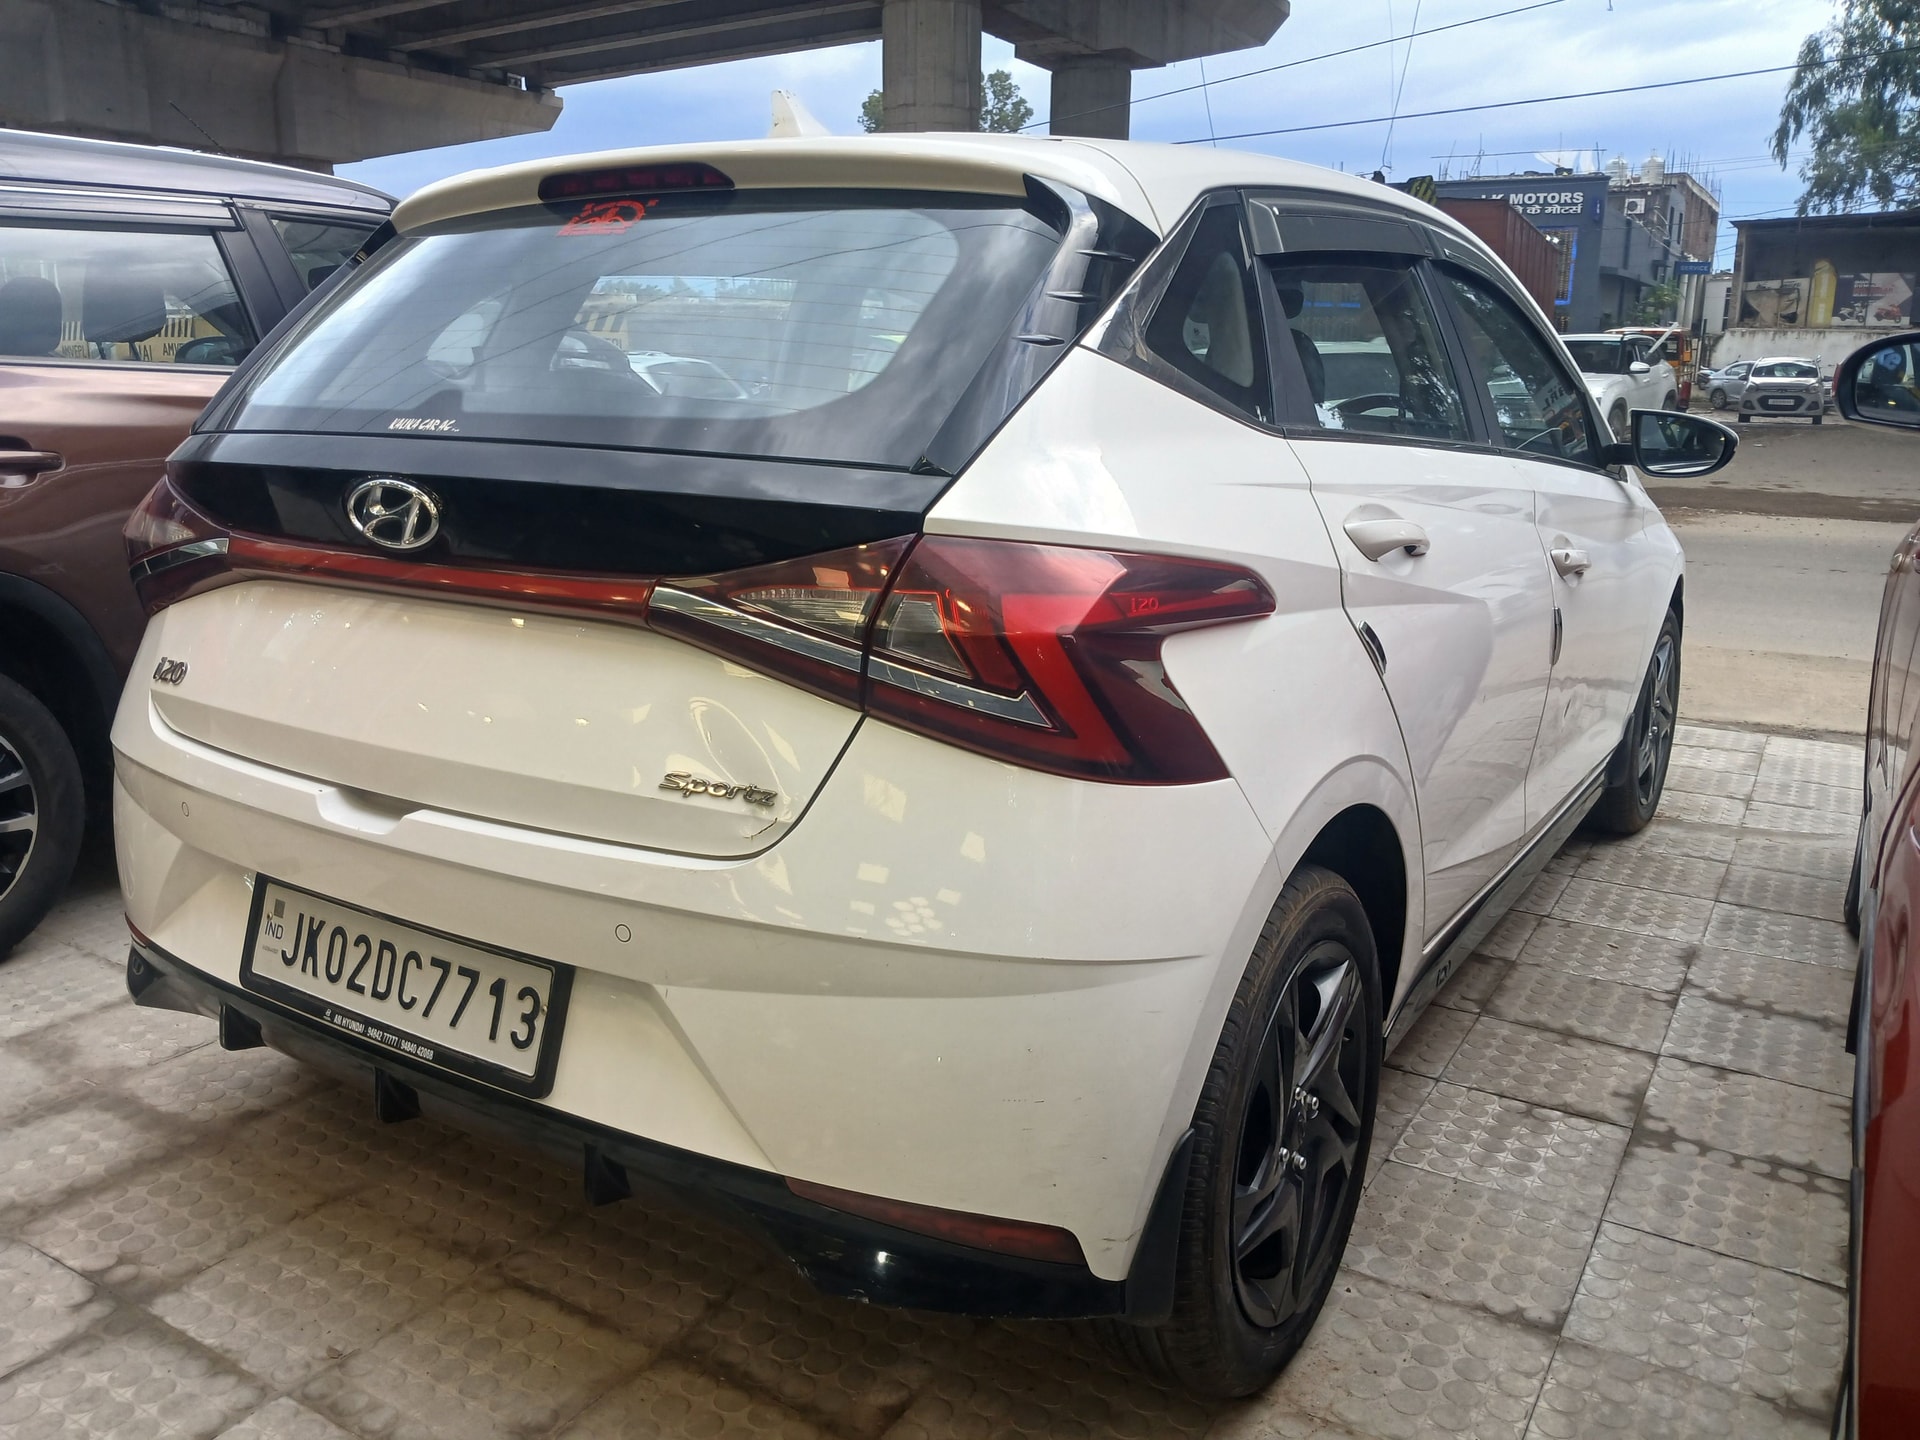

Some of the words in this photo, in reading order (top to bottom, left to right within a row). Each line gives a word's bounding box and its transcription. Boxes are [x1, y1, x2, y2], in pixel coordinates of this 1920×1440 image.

[1509, 192, 1584, 205] MOTORS
[1526, 204, 1542, 214] के
[1544, 204, 1583, 214] मोटर्स
[418, 418, 440, 432] CAR
[658, 770, 778, 806] Sportz
[264, 919, 284, 940] IND
[281, 912, 542, 1050] JK02DC7713
[341, 1017, 365, 1034] HYUNDAI
